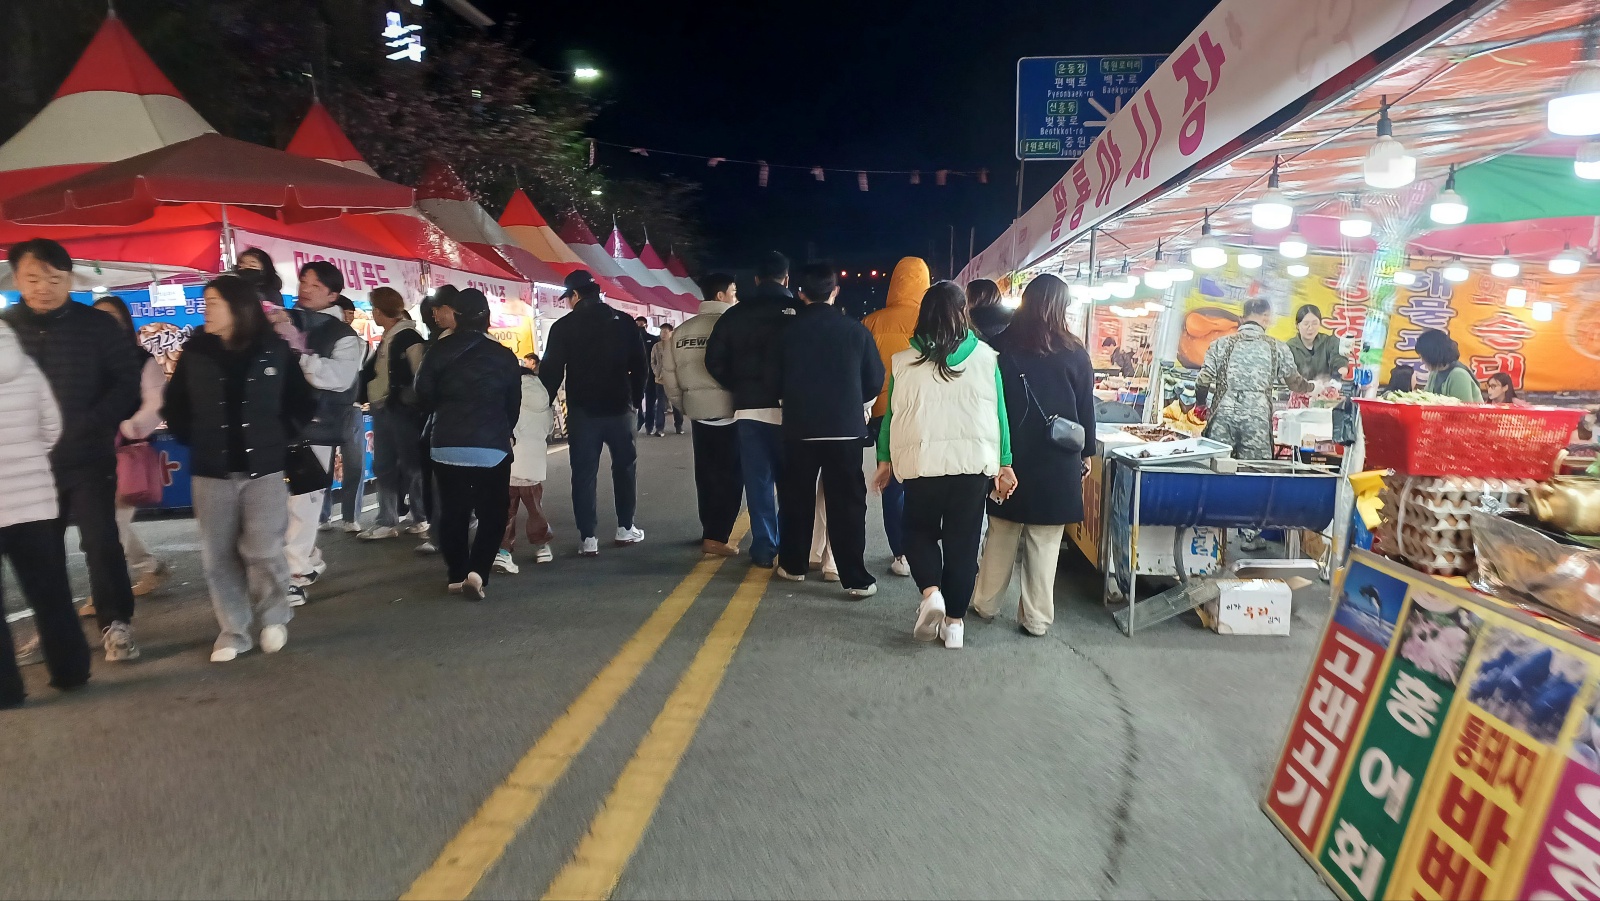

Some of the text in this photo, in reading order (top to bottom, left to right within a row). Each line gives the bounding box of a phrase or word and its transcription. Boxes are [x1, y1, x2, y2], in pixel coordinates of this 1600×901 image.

[1057, 63, 1085, 74] 운동장
[1054, 77, 1087, 88] 편백로
[1103, 74, 1138, 85] 백구로
[1047, 90, 1094, 99] Pyeonbaek-ro
[1045, 116, 1079, 127] 벚꽃로
[1040, 127, 1083, 135] Beotkkot-ro
[1060, 148, 1086, 158] Jungw
[676, 336, 708, 349] LIFEW
[1276, 630, 1375, 838] 고래고기
[1327, 668, 1443, 900] 홍어회
[1410, 772, 1514, 901] 바베
